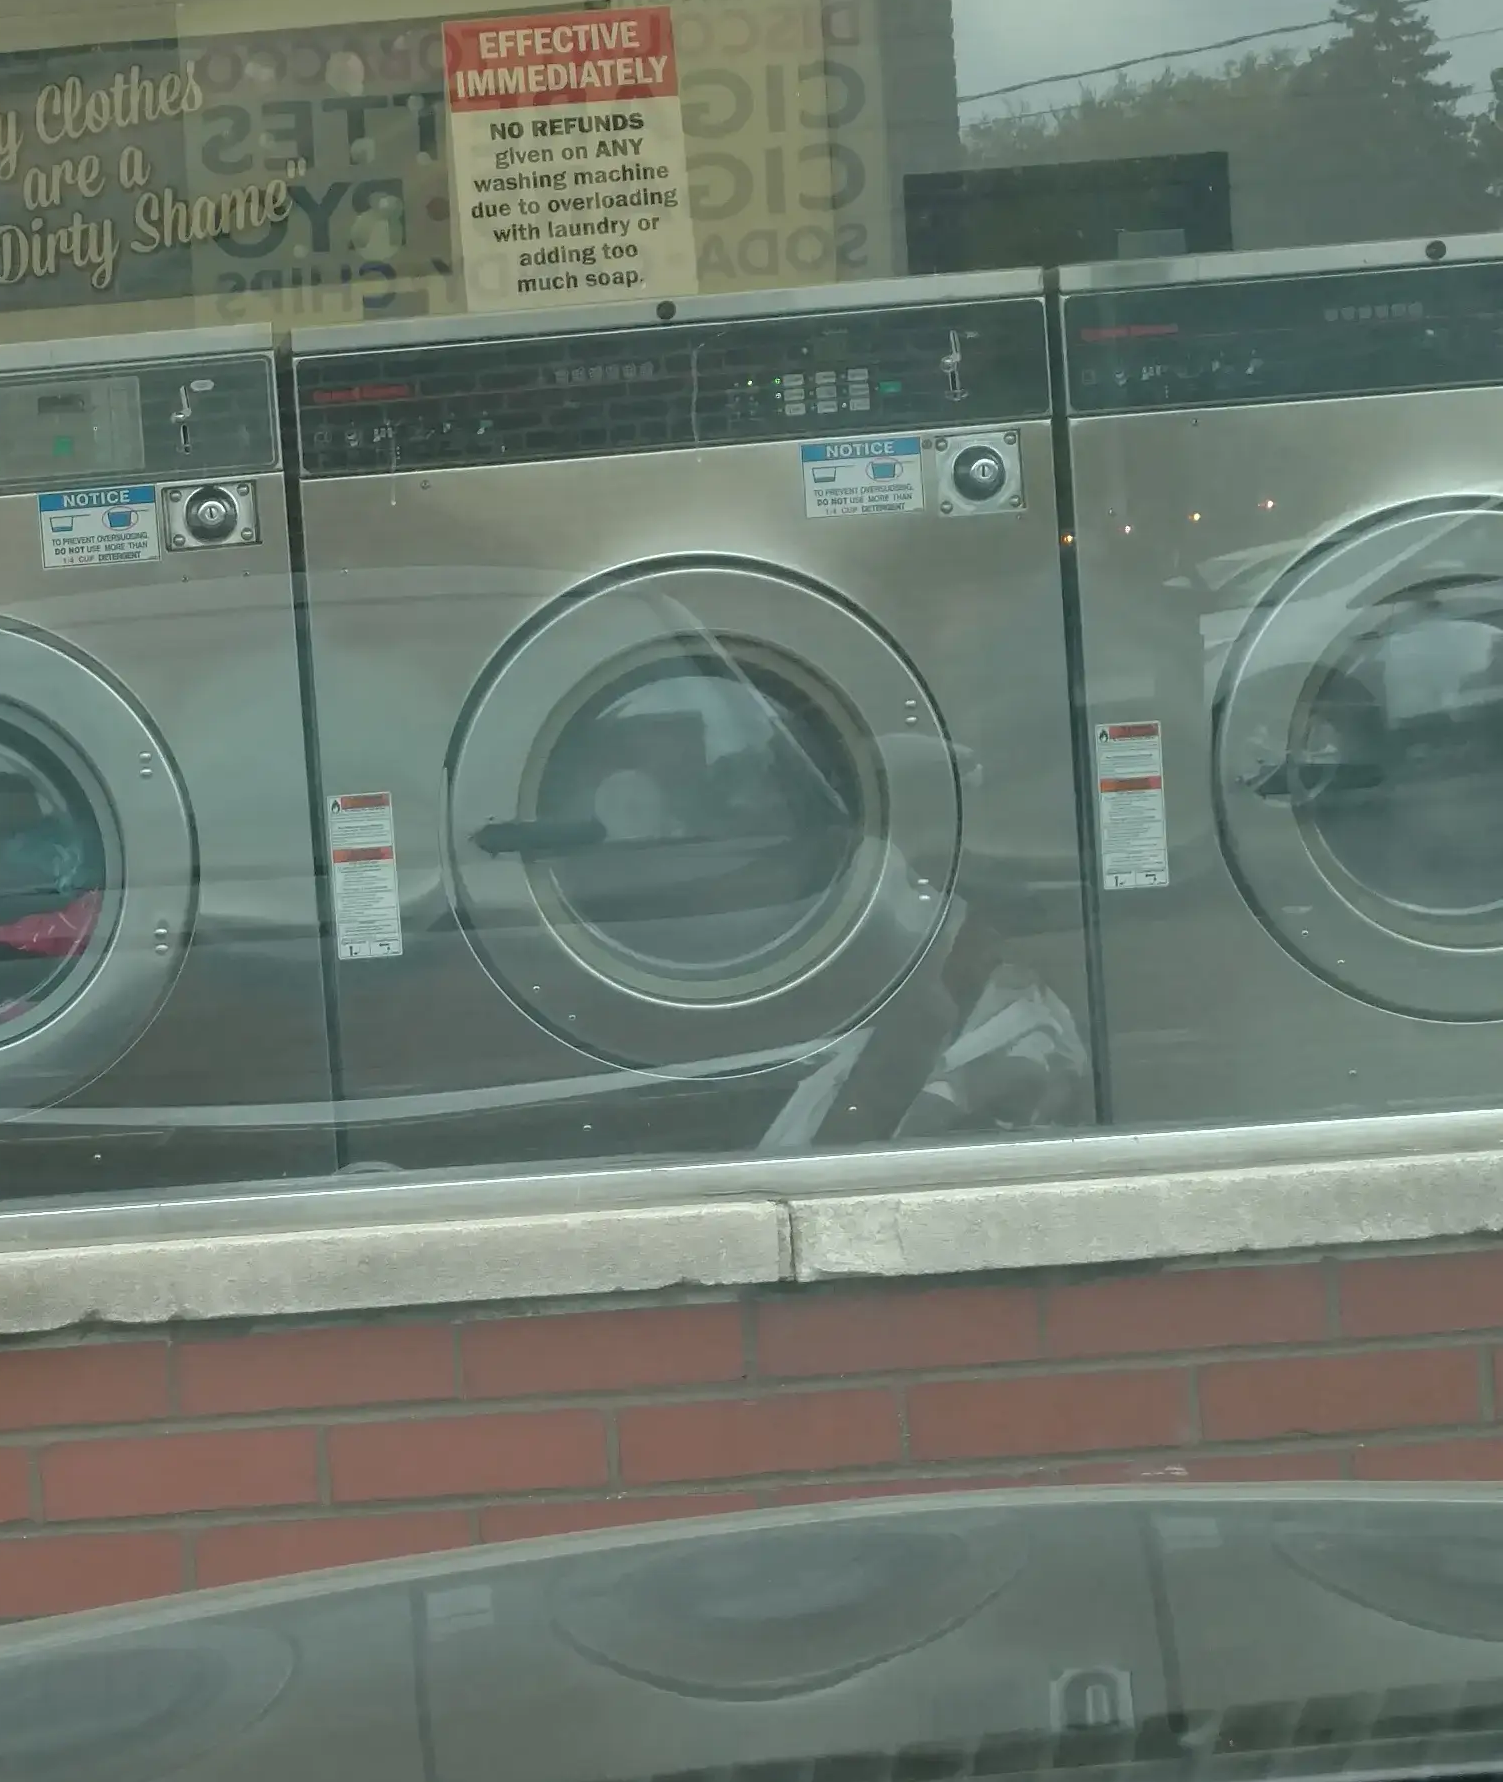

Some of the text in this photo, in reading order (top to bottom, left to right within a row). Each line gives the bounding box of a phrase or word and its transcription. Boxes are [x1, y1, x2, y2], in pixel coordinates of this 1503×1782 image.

[478, 20, 640, 60] EFFECTIVE
[455, 55, 669, 99] IMMEDIATELY
[35, 60, 203, 144] Clothes
[489, 112, 645, 141] NO REFUNDS
[495, 137, 644, 170] given on ANY
[23, 145, 150, 211] are a
[473, 162, 670, 194] washing machine
[130, 157, 307, 254] Shame"
[471, 187, 679, 220] due to overloading
[493, 215, 661, 243] with laundry or
[519, 242, 639, 267] adding too
[517, 268, 644, 293] much soap.
[825, 441, 895, 458] NOTICE
[62, 489, 130, 508] NOTICE
[51, 538, 62, 547] TO
[62, 536, 96, 546] PREVENT
[54, 547, 66, 556] DO
[68, 546, 85, 555] NOT
[127, 540, 148, 550] THAN
